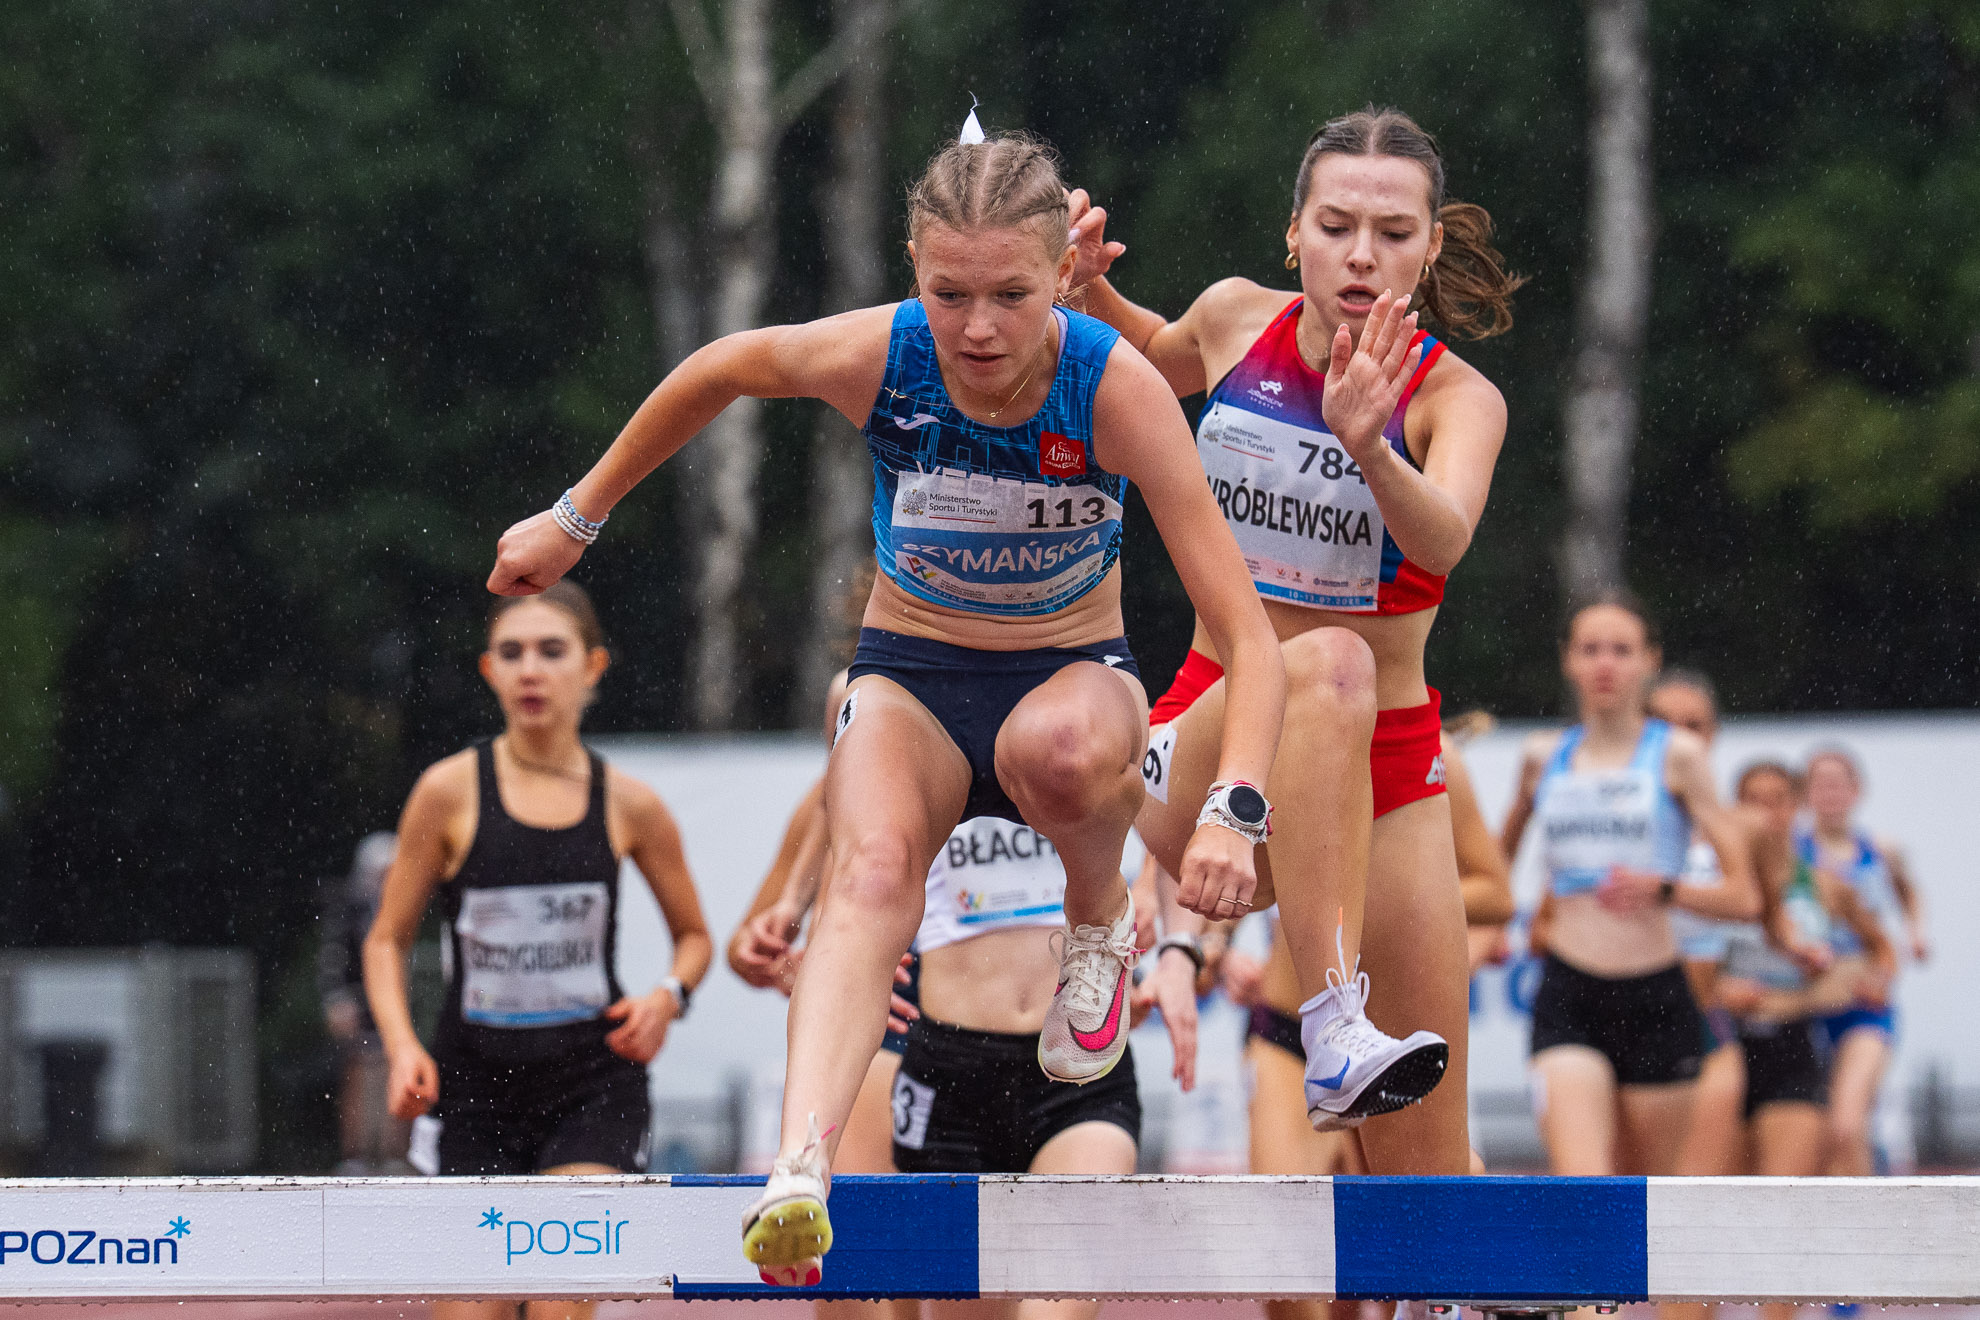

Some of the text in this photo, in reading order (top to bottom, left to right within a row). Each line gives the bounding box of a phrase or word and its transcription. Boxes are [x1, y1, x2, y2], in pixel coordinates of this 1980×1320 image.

[1222, 432, 1242, 446] Sportu
[1247, 440, 1276, 454] Turystyki
[1226, 424, 1263, 441] Ministerstwo
[1298, 440, 1367, 485] 784
[929, 492, 982, 506] Ministerstwo
[929, 503, 956, 514] Sportu
[962, 506, 998, 517] Turystyki
[1026, 496, 1106, 528] 113
[902, 531, 1100, 573] SZYMAŃSKA
[537, 893, 594, 924] 367
[898, 1085, 915, 1136] 3
